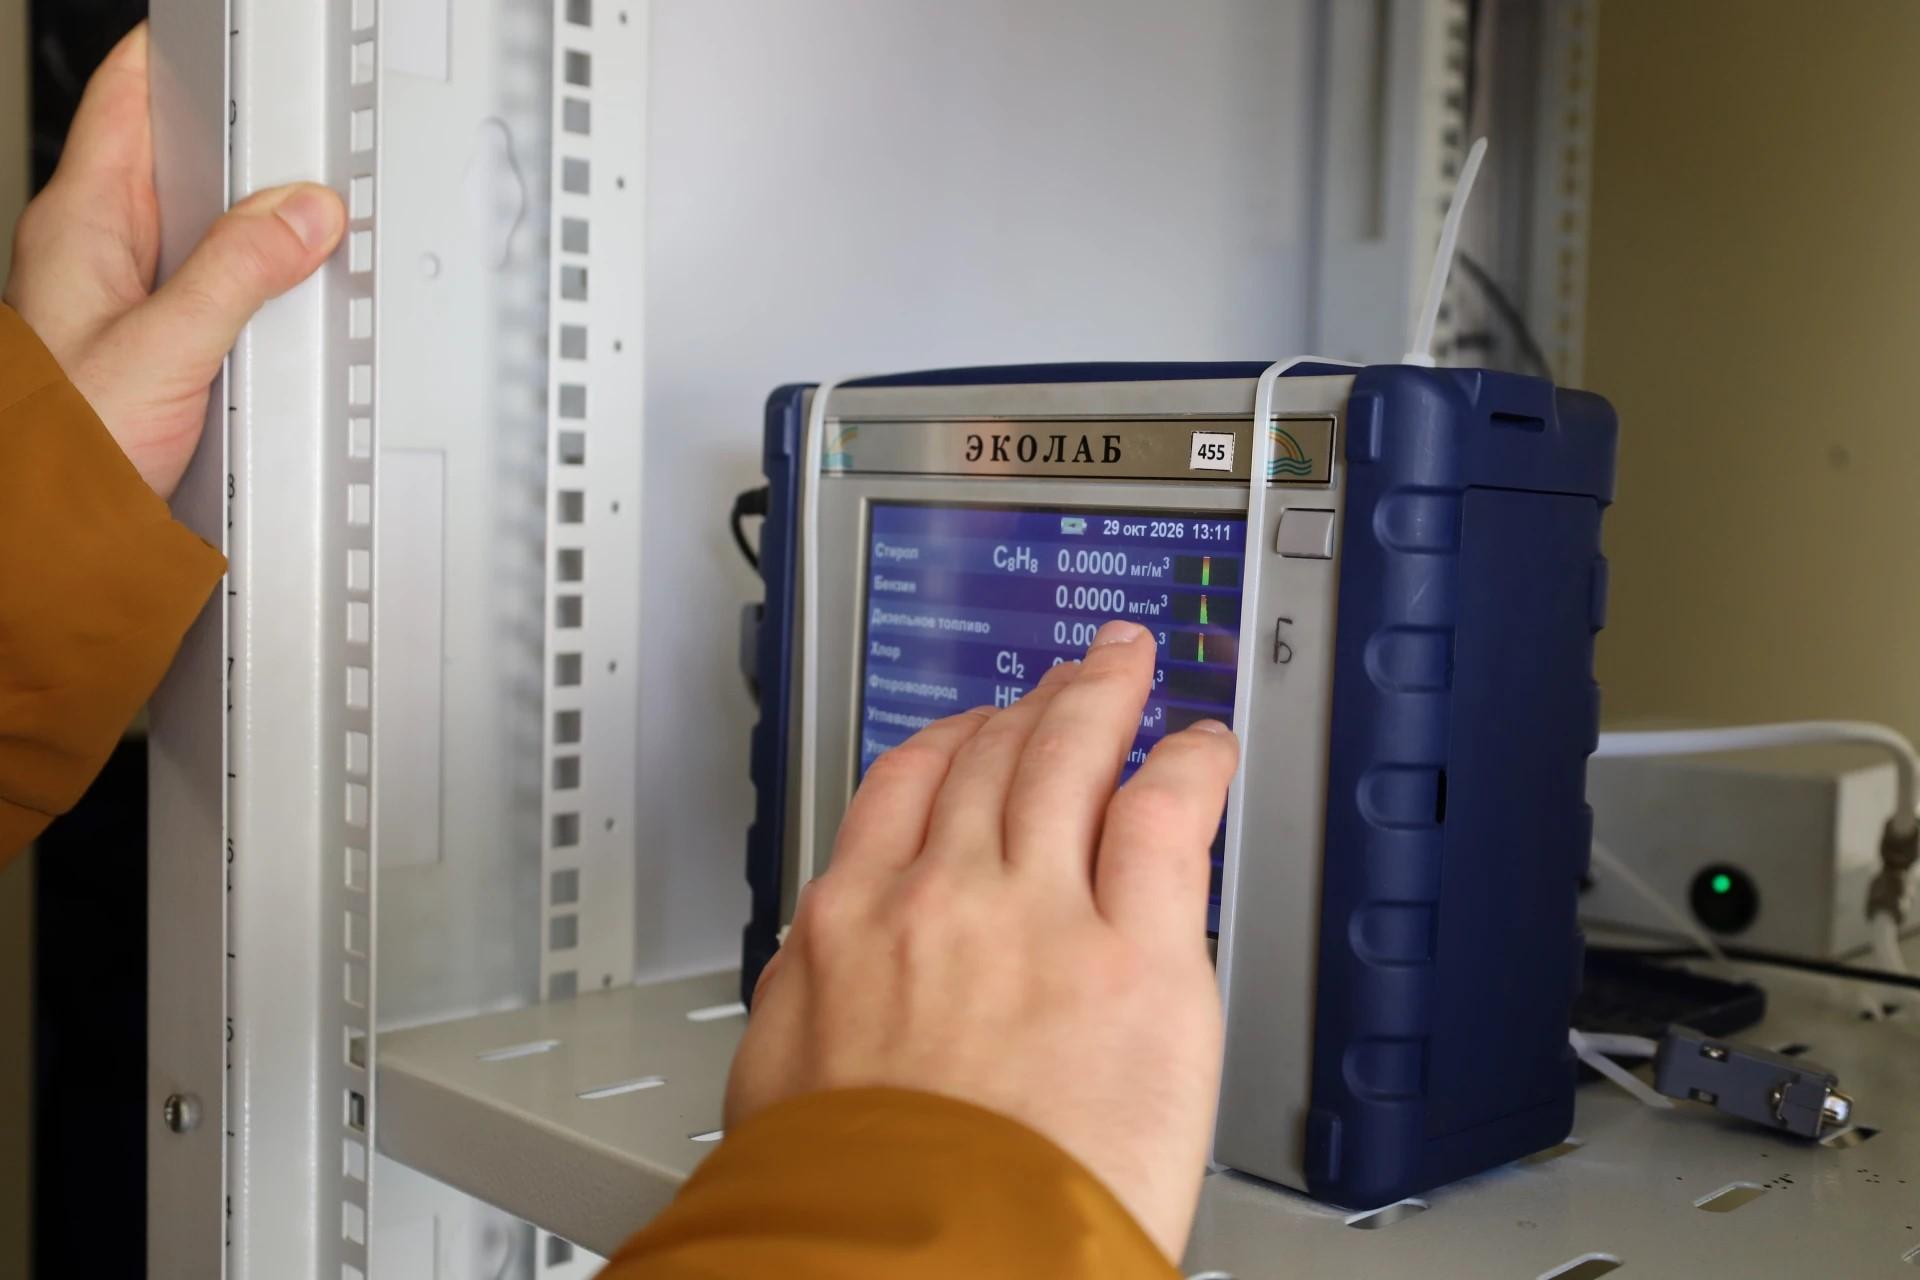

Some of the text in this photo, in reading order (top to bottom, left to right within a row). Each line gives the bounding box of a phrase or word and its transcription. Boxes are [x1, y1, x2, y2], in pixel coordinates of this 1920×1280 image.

[965, 434, 1122, 463] ЭКОЛАБ
[1197, 443, 1226, 461] 455
[1103, 520, 1230, 540] 29 окт 2026 13:11
[1057, 549, 1127, 576] 0.0000
[1056, 585, 1125, 612] 0.0000
